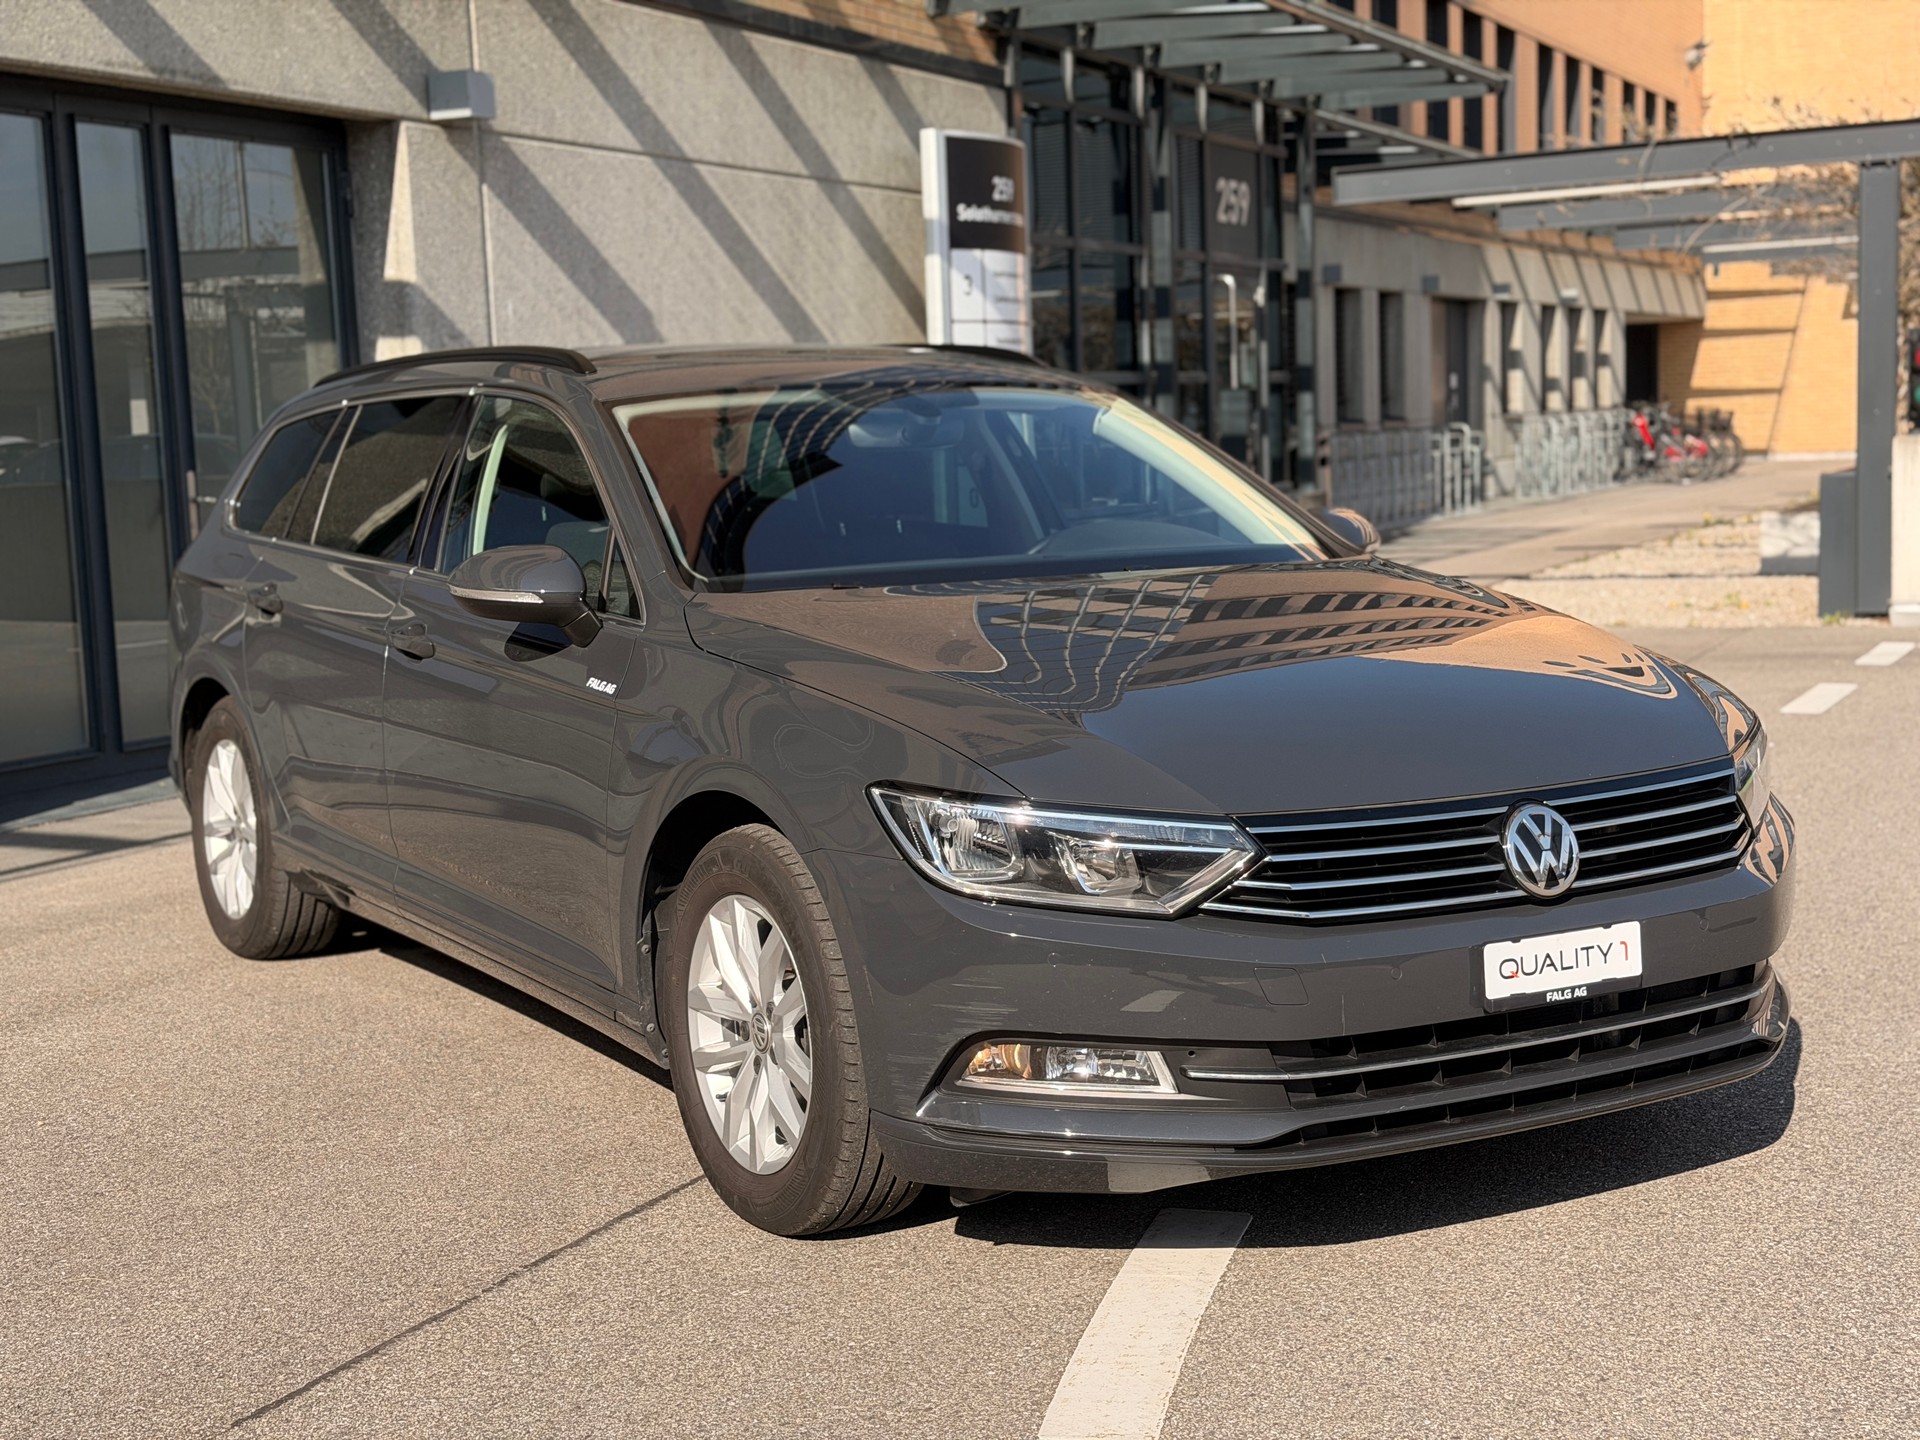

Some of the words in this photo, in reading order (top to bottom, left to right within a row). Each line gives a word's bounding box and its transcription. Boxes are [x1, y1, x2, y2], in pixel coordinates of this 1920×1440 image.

[1214, 176, 1251, 227] 259
[586, 677, 607, 691] FALG
[603, 683, 617, 695] AG
[1546, 988, 1572, 1002] FALG
[1573, 986, 1587, 997] AG
